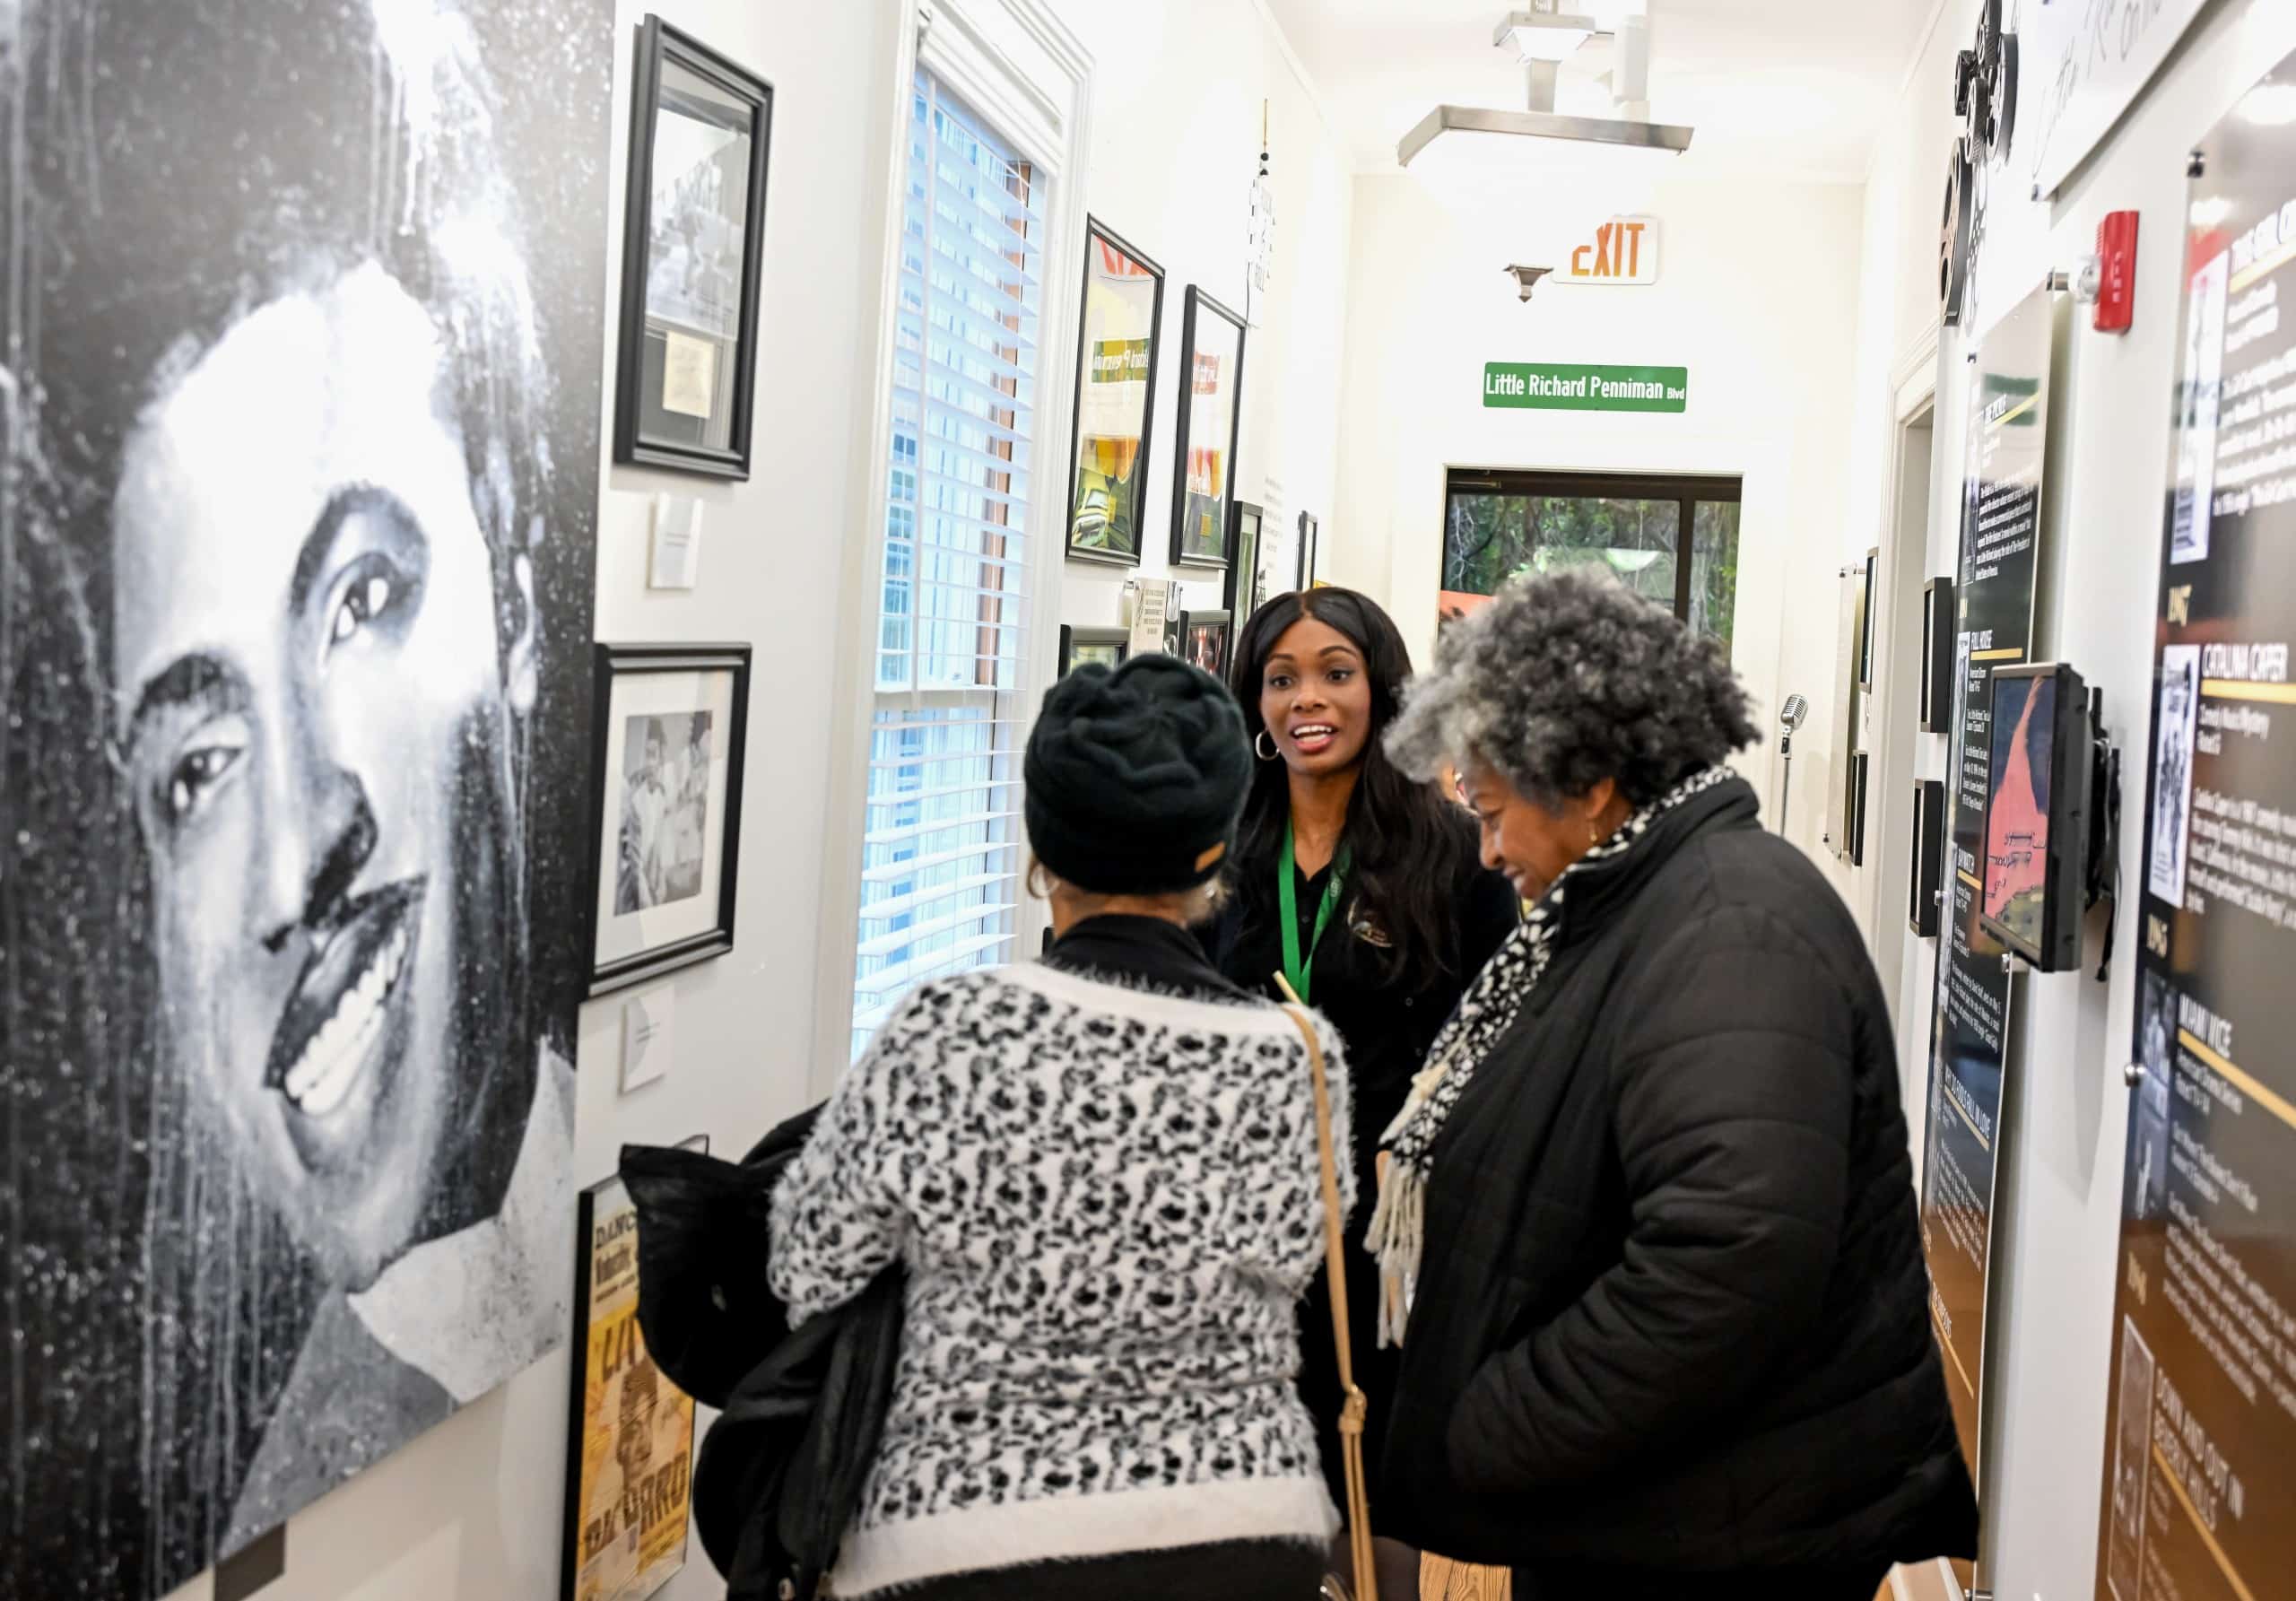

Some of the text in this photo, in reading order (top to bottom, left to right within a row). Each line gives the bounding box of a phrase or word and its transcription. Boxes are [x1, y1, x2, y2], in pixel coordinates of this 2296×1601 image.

[1485, 373, 1685, 400] Little Richard Penniman Blvd
